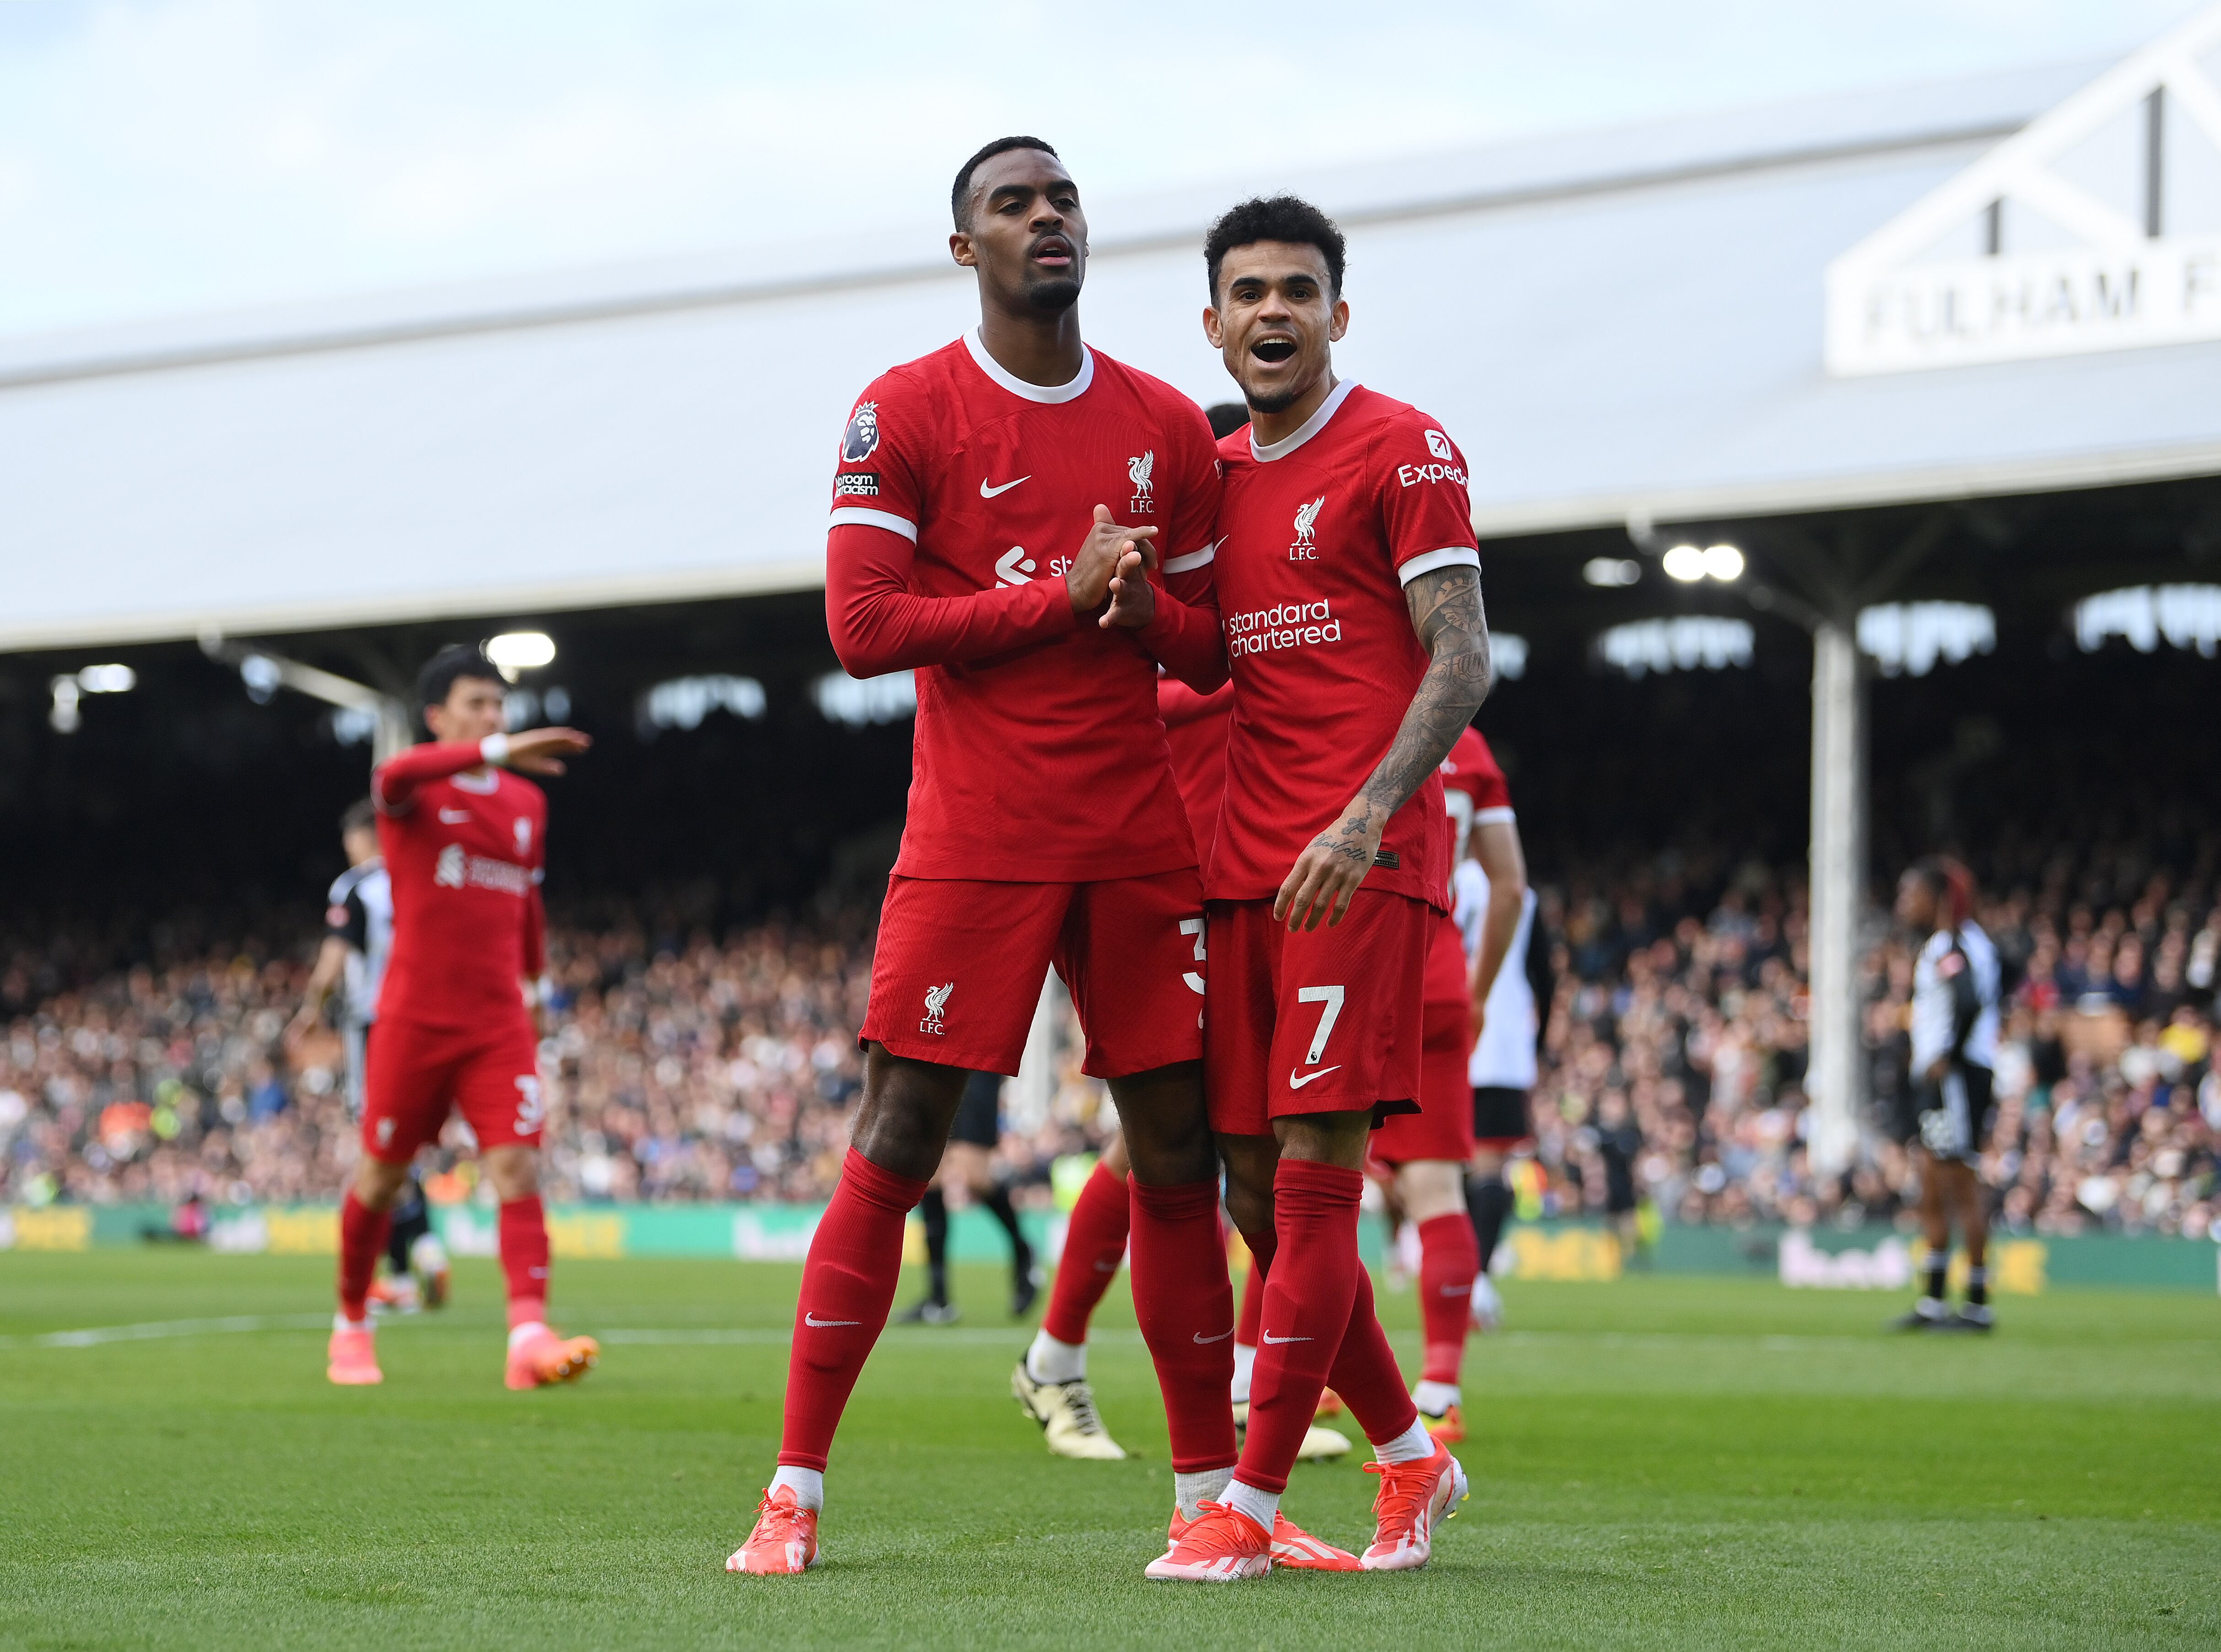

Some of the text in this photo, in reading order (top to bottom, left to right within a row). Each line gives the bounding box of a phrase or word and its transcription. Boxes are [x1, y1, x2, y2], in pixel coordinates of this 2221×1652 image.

[1864, 267, 2144, 347] FULHAM
[842, 475, 873, 485] room
[841, 484, 879, 495] racism
[1130, 500, 1154, 513] L.F.C.
[1289, 547, 1319, 560] L.F.C.
[1229, 598, 1330, 635] standard
[1231, 619, 1342, 658] chartered
[920, 1021, 945, 1035] L.F.C.
[1298, 985, 1345, 1065] 7
